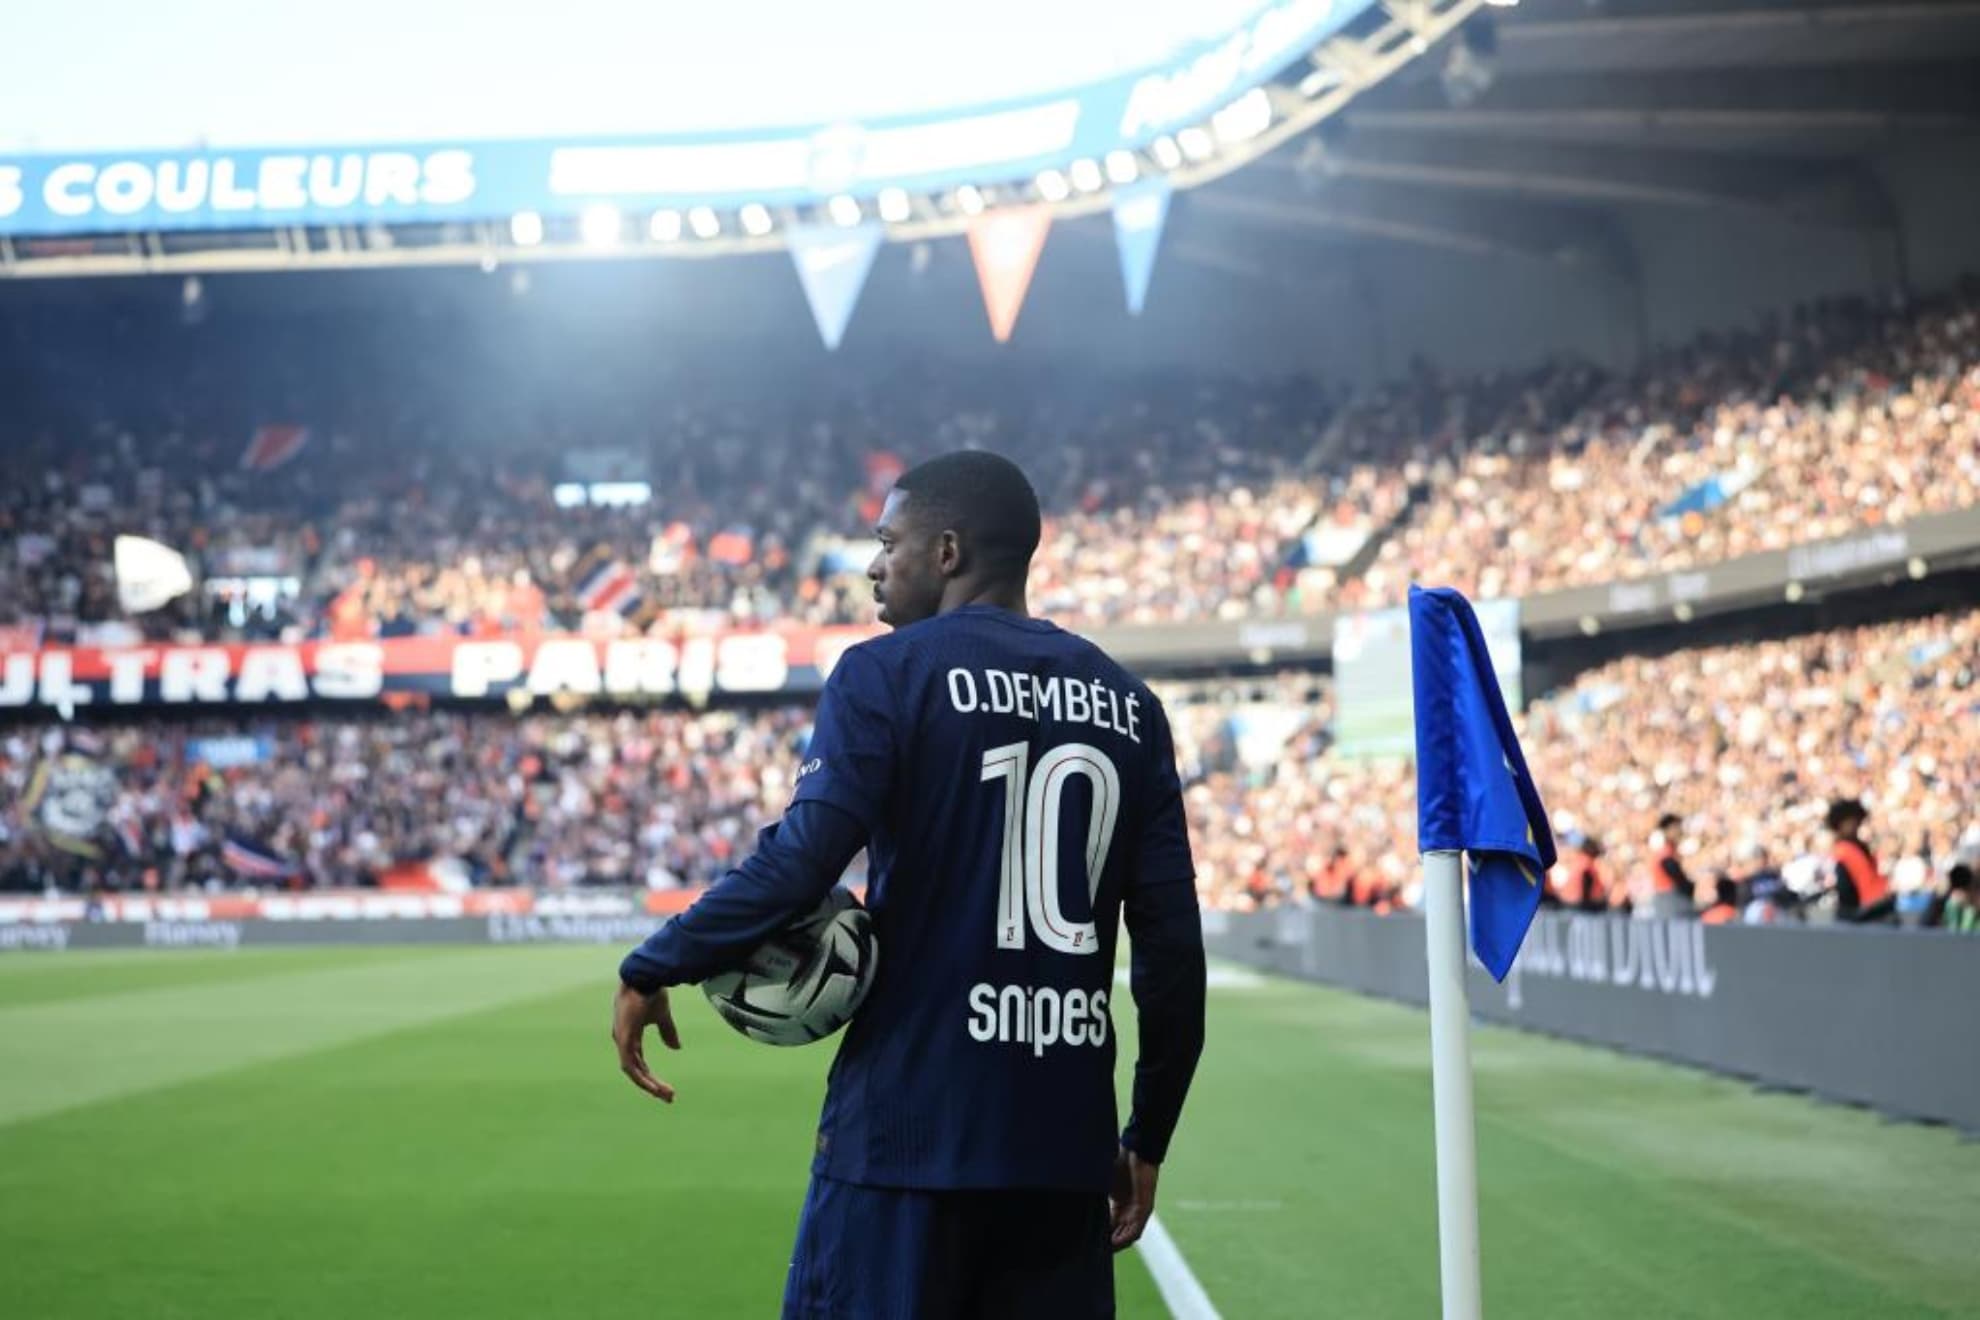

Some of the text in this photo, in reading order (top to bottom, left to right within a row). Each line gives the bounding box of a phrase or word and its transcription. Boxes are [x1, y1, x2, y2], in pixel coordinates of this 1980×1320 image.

[43, 150, 476, 216] COULEURS
[451, 634, 788, 698] PARIS
[947, 667, 1141, 744] O.DEMBÉLÉ
[980, 740, 1121, 955] 10
[967, 981, 1108, 1058] snipes
